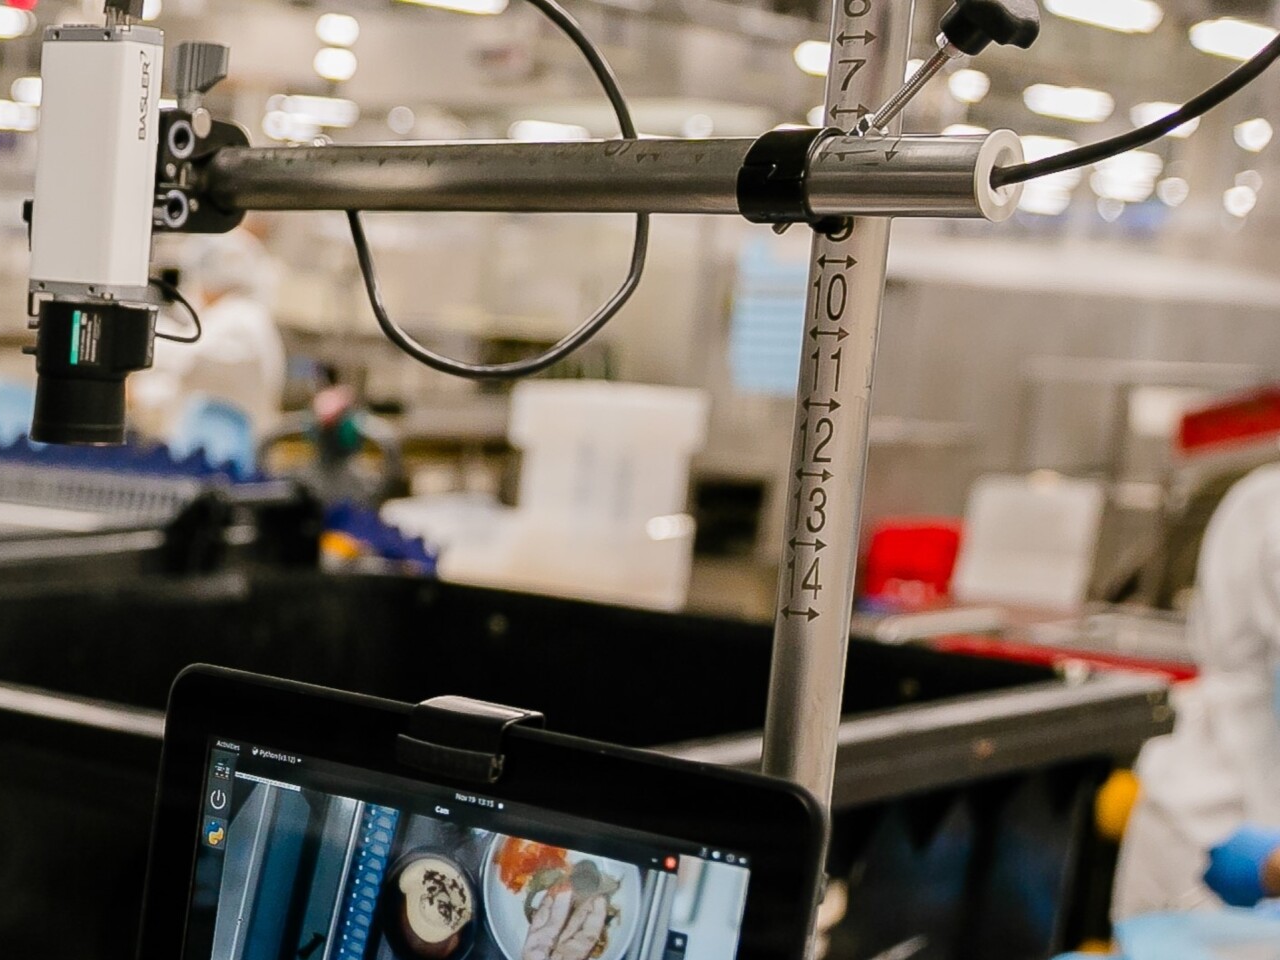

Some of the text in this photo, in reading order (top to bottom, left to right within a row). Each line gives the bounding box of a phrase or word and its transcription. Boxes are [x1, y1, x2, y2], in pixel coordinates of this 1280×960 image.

[838, 59, 867, 91] 7
[138, 62, 151, 140] BASLER
[813, 273, 848, 321] 10
[811, 346, 842, 393] 11
[800, 417, 834, 463] 12
[794, 486, 827, 533] 13
[787, 556, 823, 600] 14
